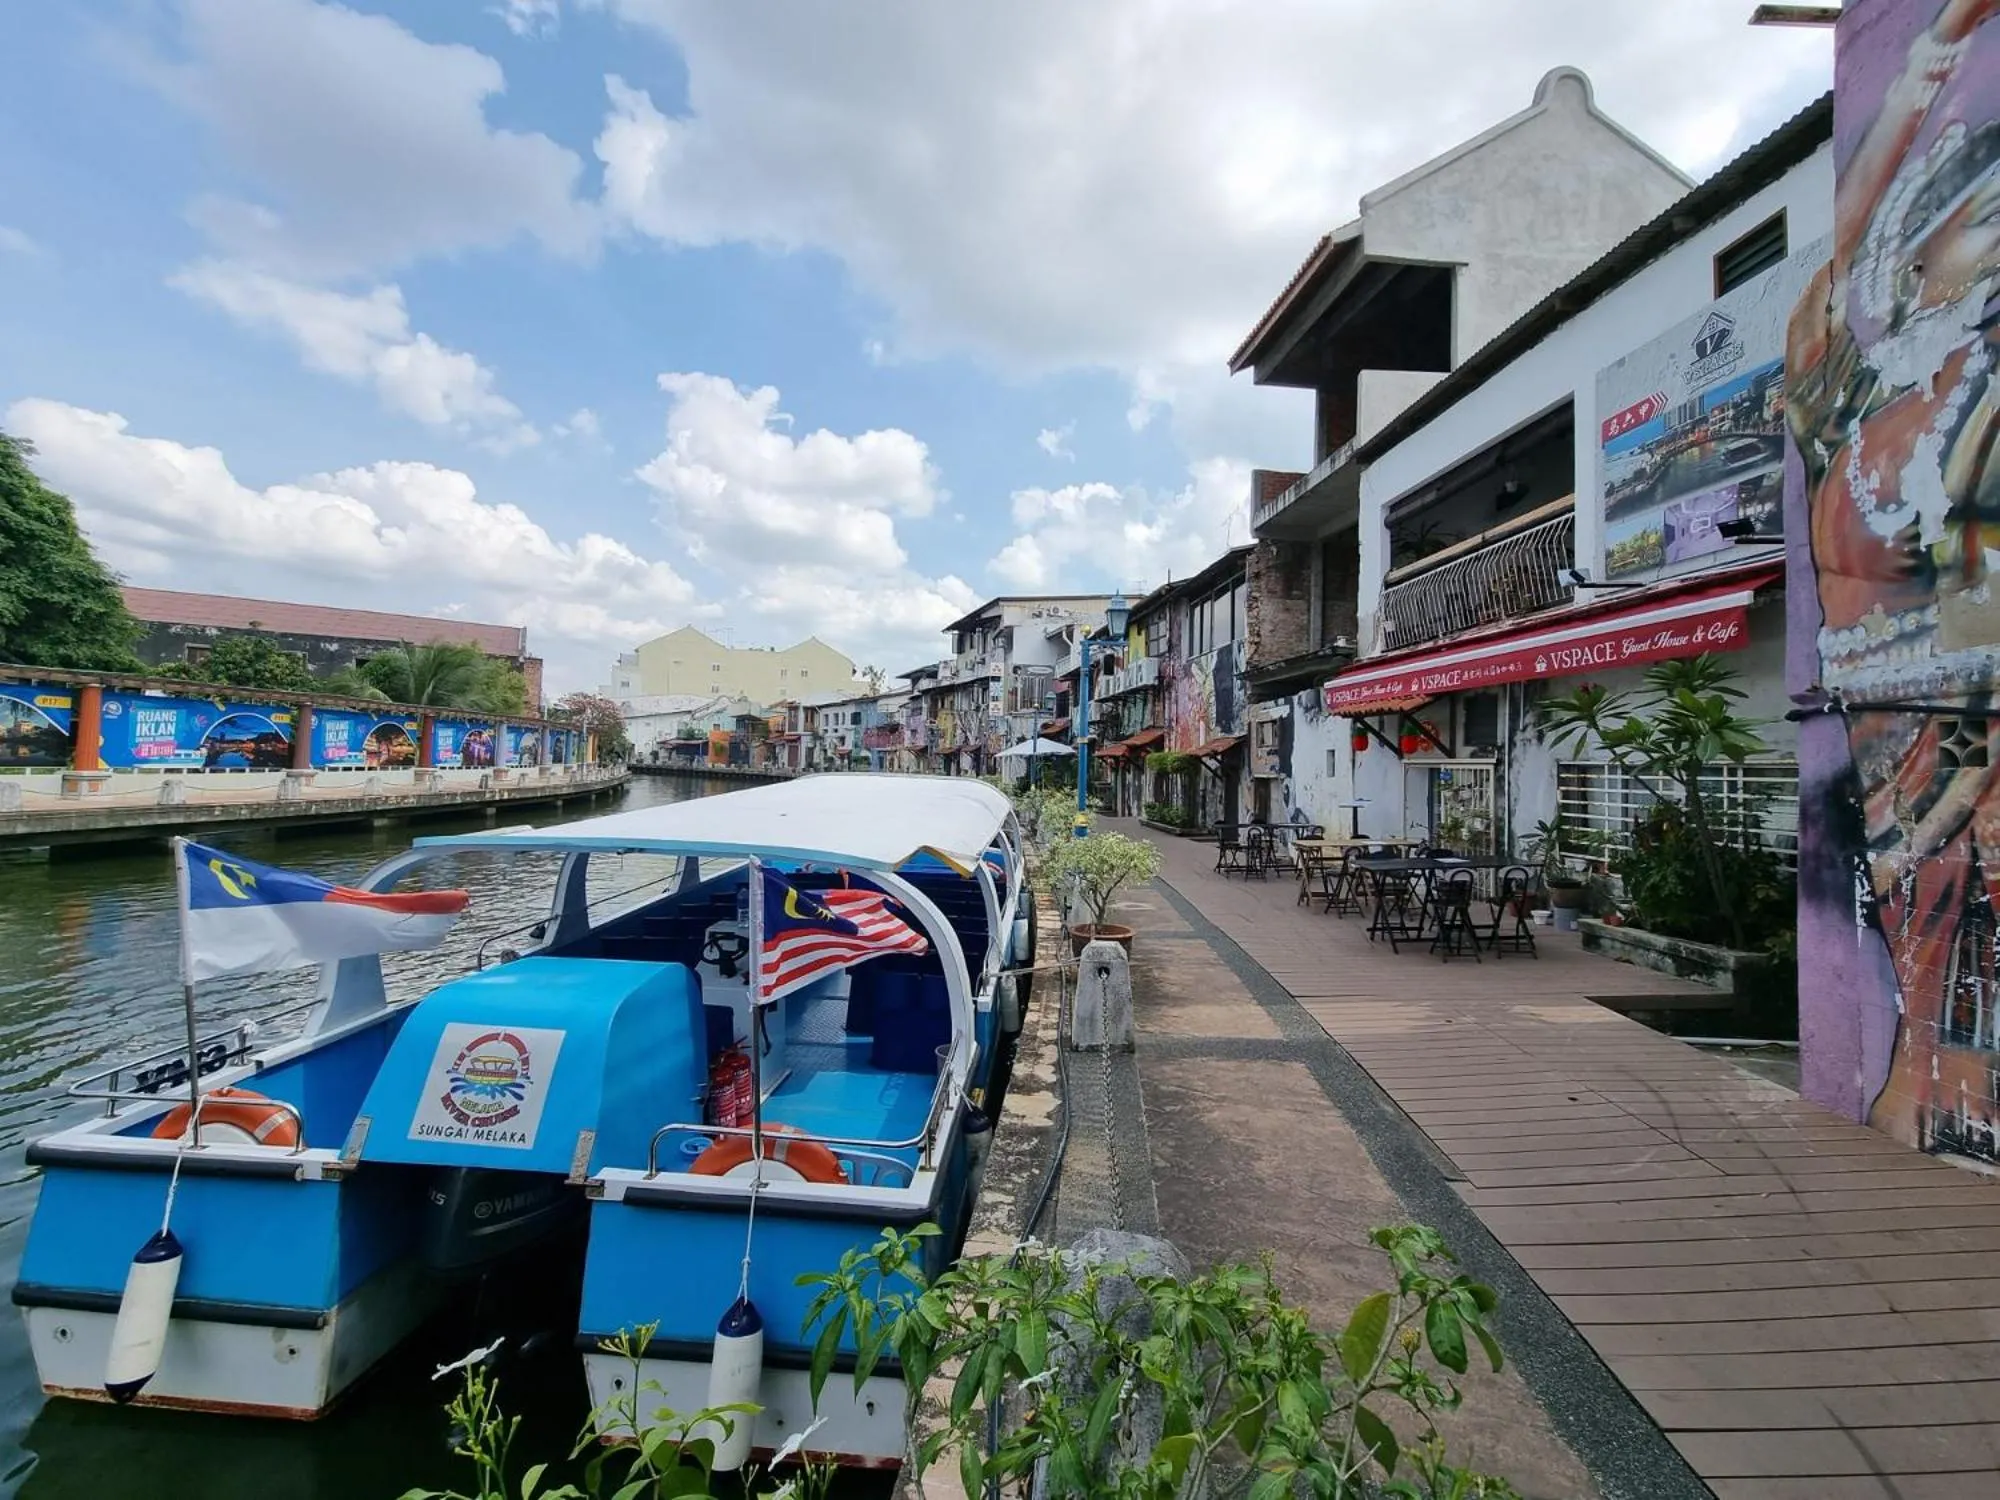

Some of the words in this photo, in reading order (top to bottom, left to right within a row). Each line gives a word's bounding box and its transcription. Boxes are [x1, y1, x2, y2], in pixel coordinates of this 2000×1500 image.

[1550, 641, 1617, 669] VSPACE
[1620, 637, 1650, 659] Guest
[1652, 630, 1689, 649] House
[1692, 625, 1705, 642] &
[1708, 621, 1739, 643] Cafe
[1421, 670, 1460, 690] VSPACE
[137, 710, 176, 721] RUANG
[136, 722, 176, 736] IKLAN
[440, 1092, 470, 1126] RIVER
[418, 1124, 470, 1139] SUNGAI
[473, 1129, 526, 1143] MELAKA
